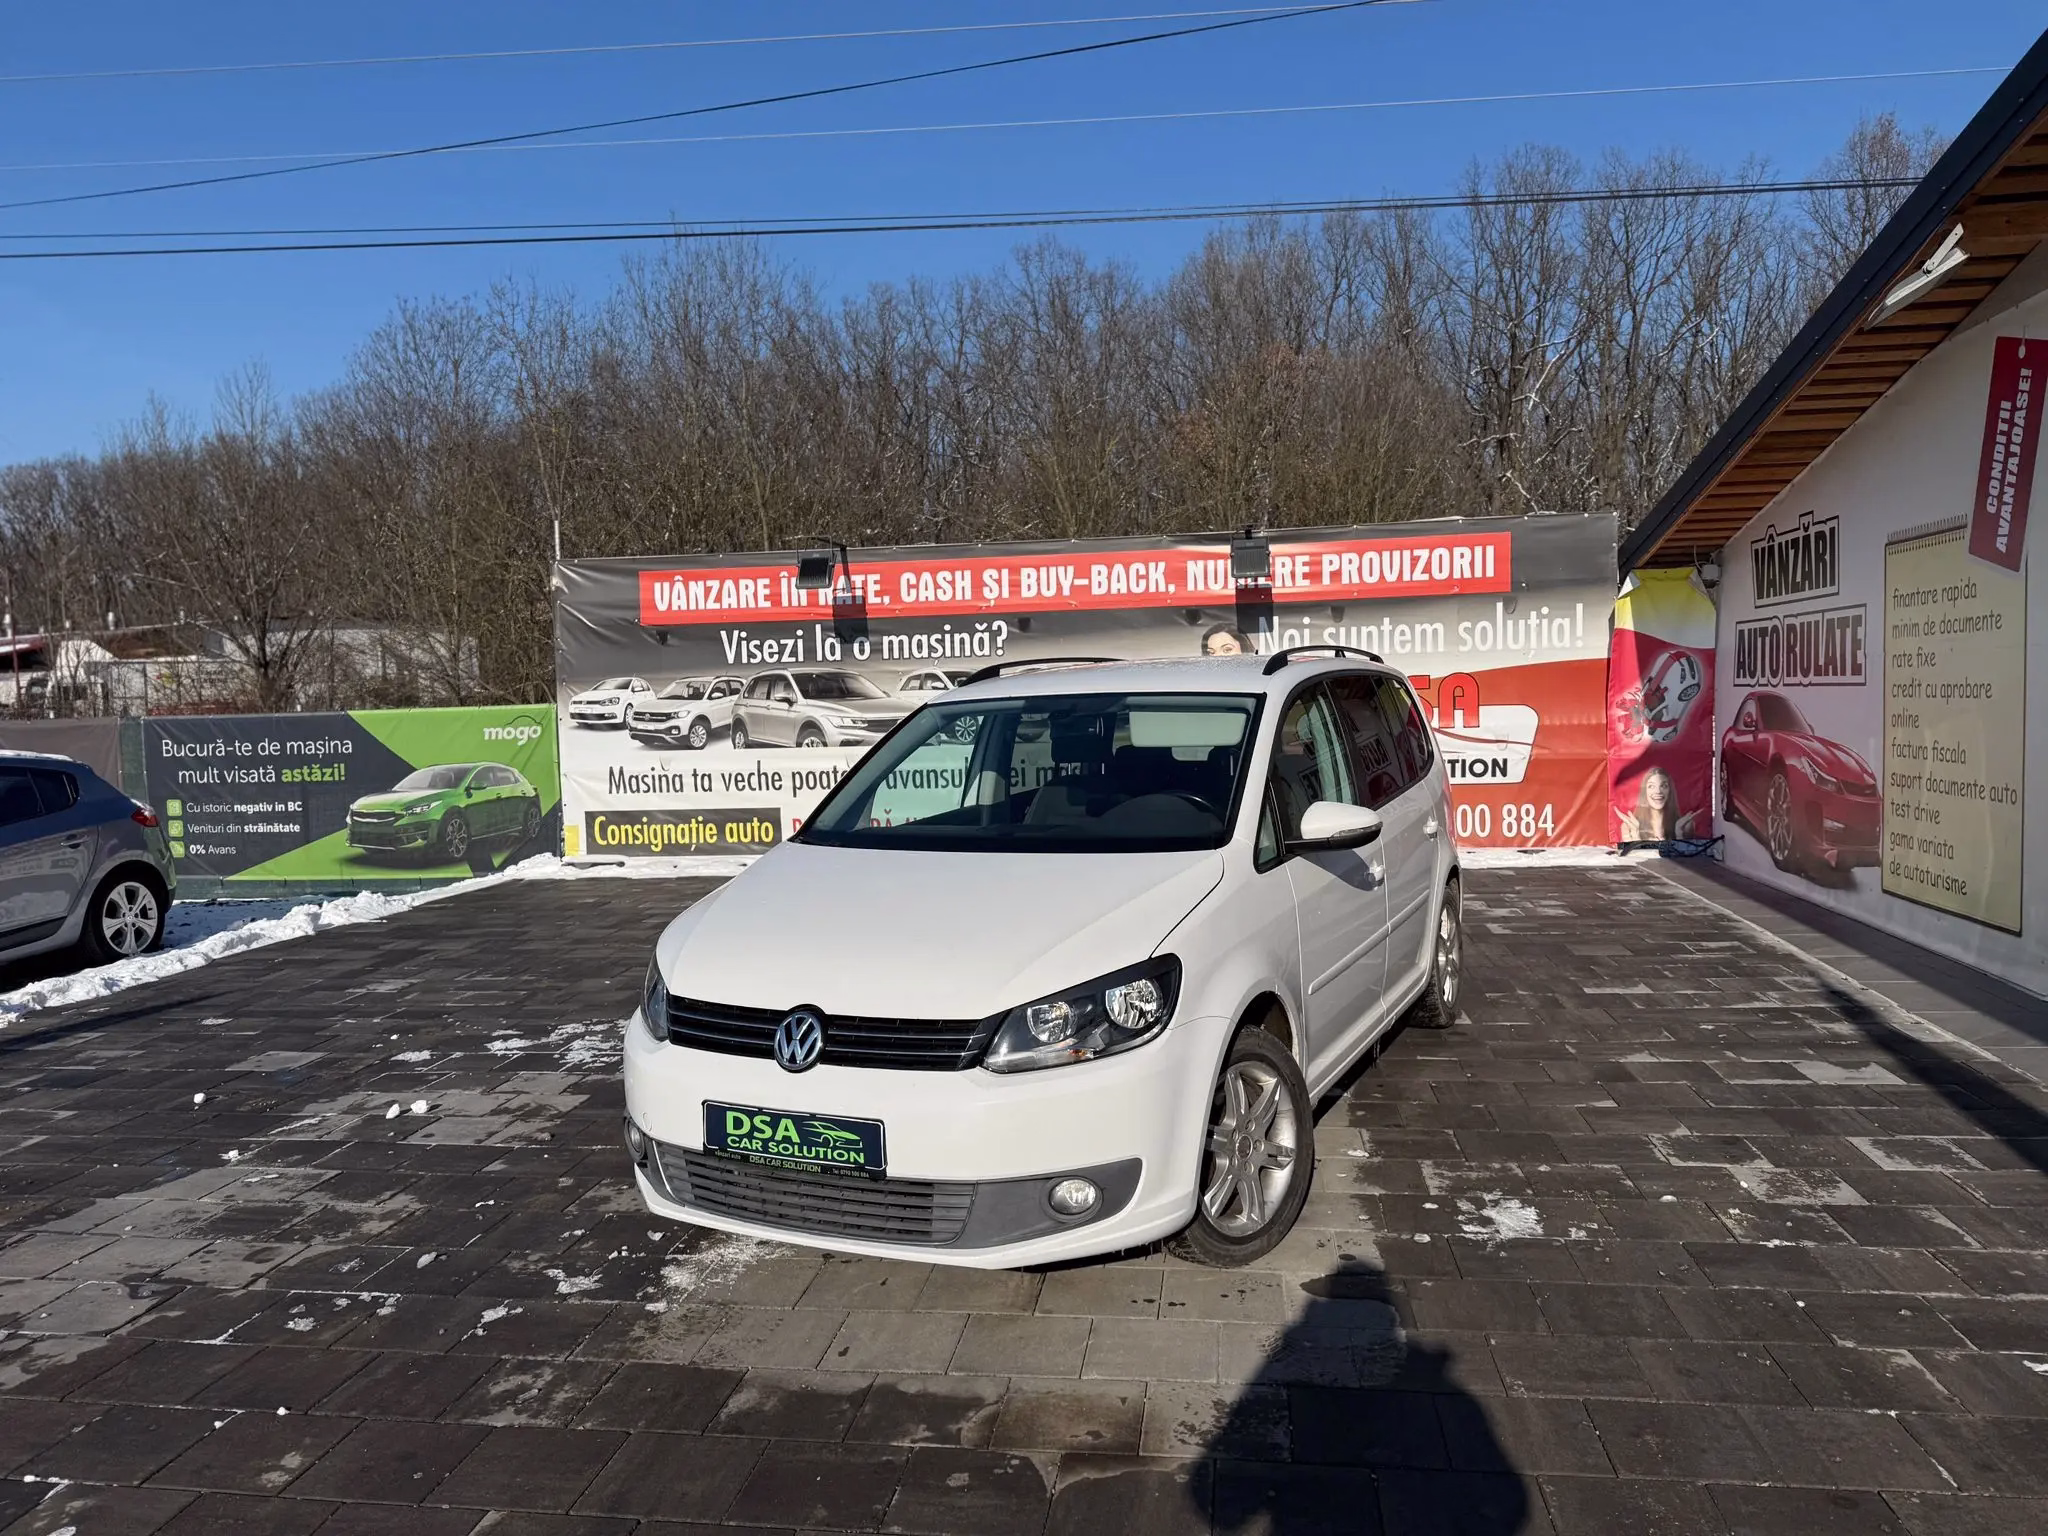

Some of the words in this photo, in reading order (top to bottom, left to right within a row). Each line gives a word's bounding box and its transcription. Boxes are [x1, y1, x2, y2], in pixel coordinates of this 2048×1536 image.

[1986, 399, 2012, 514] CONDITII
[1995, 367, 2032, 553] AVANTAJOASE!
[1753, 520, 1836, 600] VÂNZĂRI
[653, 575, 771, 612] VÂNZARE
[900, 569, 972, 603] CASH
[1020, 561, 1176, 599] BUY-BACK,
[1321, 545, 1496, 585] PROVIZORII
[1892, 587, 1938, 610] finantare
[1941, 576, 1978, 608] rapida
[1322, 617, 1444, 654] suntem
[1457, 601, 1584, 661] soluția!
[1892, 618, 1920, 639] minim
[1923, 614, 1936, 636] de
[1939, 609, 2003, 634] documente
[719, 629, 805, 665] Visezi
[815, 623, 842, 662] la
[852, 636, 871, 661] o
[881, 620, 1008, 665] mașină?
[1892, 650, 1913, 669] rate
[1916, 646, 1937, 668] fixe
[1891, 677, 1922, 698] credit
[1925, 682, 1937, 699] cu
[1940, 676, 1993, 705] aprobare
[1891, 707, 1920, 728] online
[161, 737, 253, 757] Bucură-te
[258, 737, 281, 755] de
[286, 736, 353, 758] mașina
[483, 725, 542, 746] mogo
[1891, 737, 1928, 761] factura
[1932, 740, 1967, 765] fiscala
[178, 766, 221, 784] mult
[223, 765, 276, 783] visată
[281, 763, 346, 782] astăzi!
[691, 768, 713, 793] ta
[720, 760, 783, 792] veche
[1890, 771, 1922, 795] suport
[1925, 771, 1986, 800] documente
[1989, 783, 2018, 805] auto
[186, 802, 200, 812] Cu
[202, 802, 232, 813] istoric
[234, 802, 273, 814] negativ
[275, 802, 286, 812] in
[287, 801, 303, 811] BC
[1502, 803, 1555, 838] 884
[1890, 799, 1911, 818] test
[1913, 803, 1941, 825] drive
[187, 823, 224, 833] Venituri
[227, 822, 242, 833] din
[243, 822, 301, 833] străinătate
[594, 815, 718, 852] Consignație
[724, 817, 774, 843] auto
[189, 844, 206, 854] 0%
[208, 844, 237, 855] Avans
[1889, 831, 1914, 851] gama
[1916, 835, 1954, 860] variata
[1889, 857, 1901, 877] de
[1903, 865, 1968, 896] autoturisme
[725, 1110, 801, 1143] DSA
[727, 1136, 763, 1151] CAR
[768, 1142, 865, 1164] SOLUTION
[749, 1155, 765, 1165] DSA
[766, 1158, 781, 1168] CAR
[782, 1160, 822, 1173] SOLUTION
